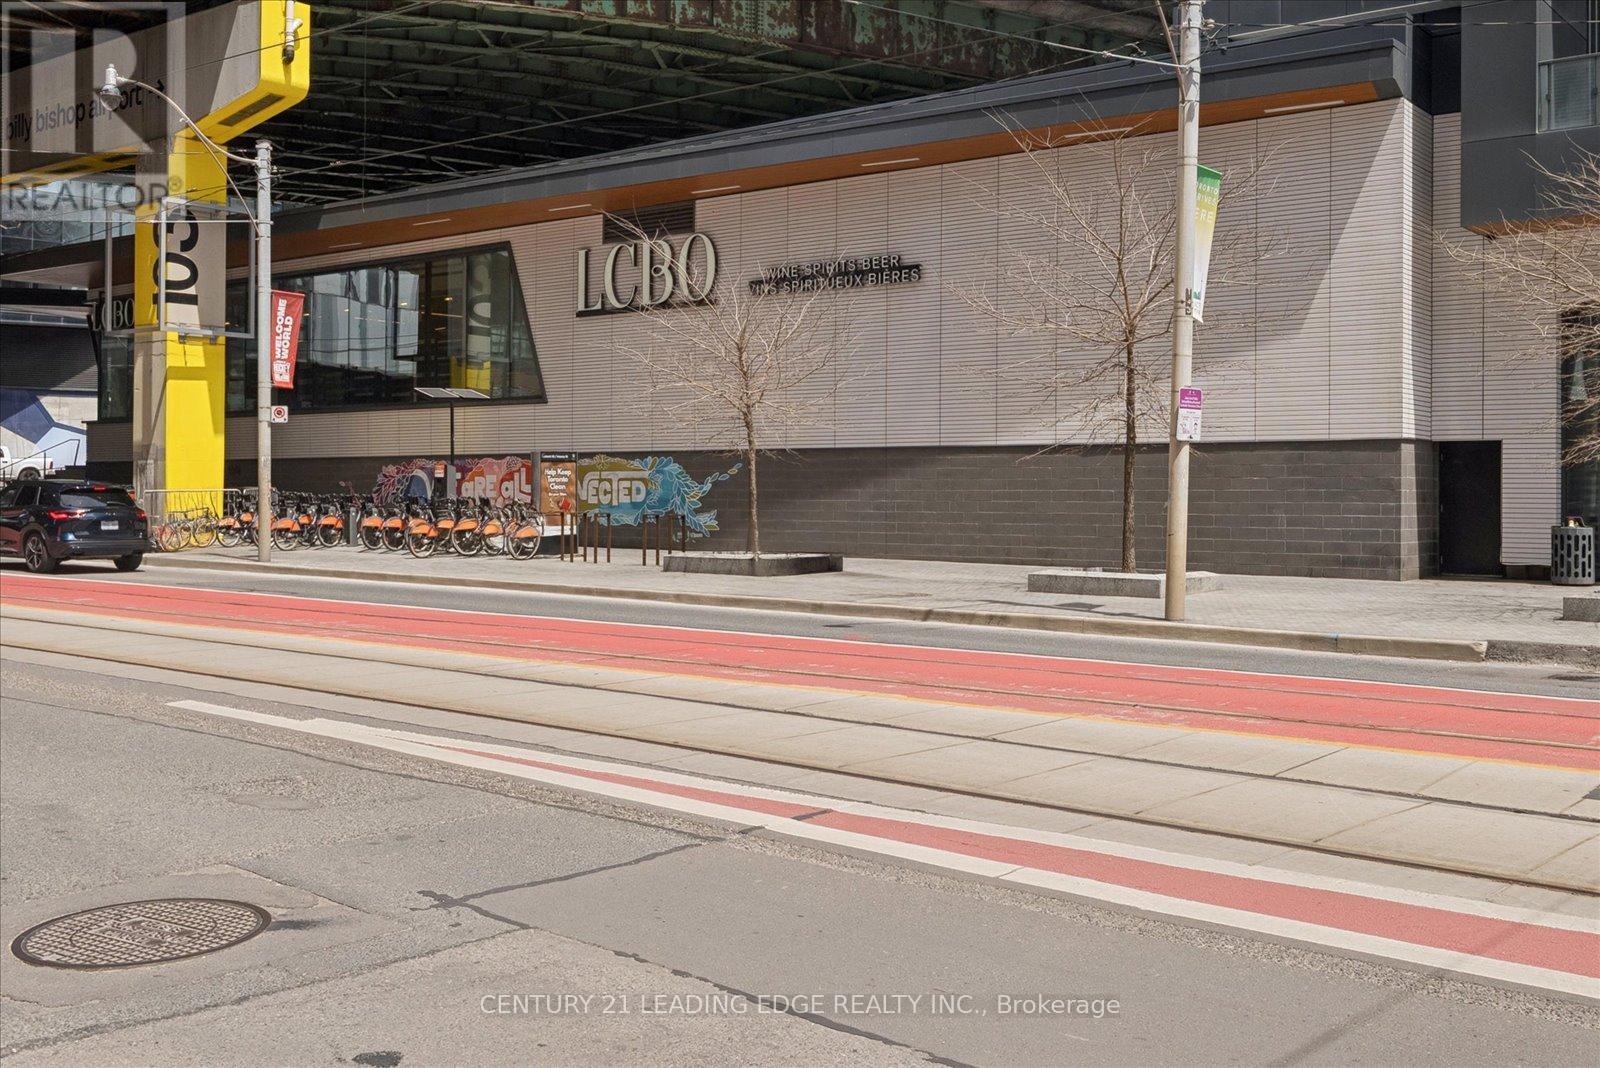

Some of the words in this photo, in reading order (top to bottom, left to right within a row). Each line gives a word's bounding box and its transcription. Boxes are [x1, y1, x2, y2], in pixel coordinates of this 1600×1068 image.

[36, 102, 86, 133] bishop
[89, 83, 142, 120] aiort
[1194, 207, 1214, 222] ERE
[576, 233, 716, 312] LCBO
[765, 265, 799, 279] WINE
[804, 260, 856, 276] SPIRITS
[862, 254, 900, 270] BEER
[783, 274, 863, 294] SPIRITUEUX
[868, 268, 919, 285] BIÈRES
[275, 298, 287, 359] WELCOME
[281, 316, 293, 359] WORLD
[577, 471, 648, 506] NECTED
